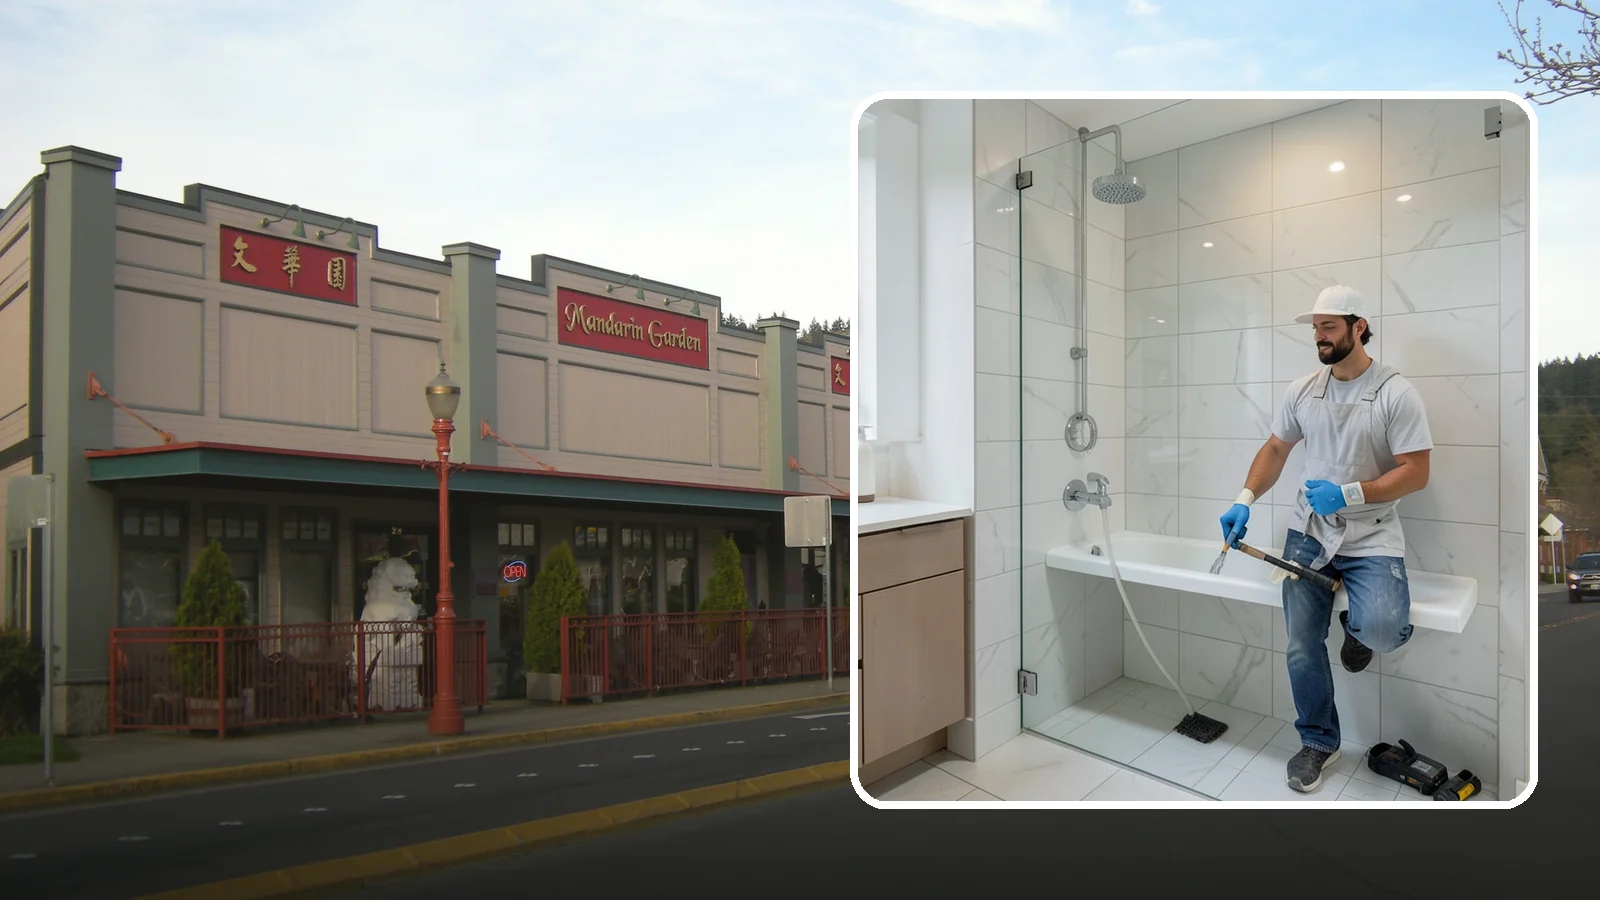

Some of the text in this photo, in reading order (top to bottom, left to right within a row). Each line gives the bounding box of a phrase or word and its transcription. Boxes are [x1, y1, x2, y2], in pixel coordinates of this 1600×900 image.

[231, 236, 346, 290] 文華園
[564, 302, 701, 352] Mandarin Garden
[503, 565, 527, 578] OPEN
